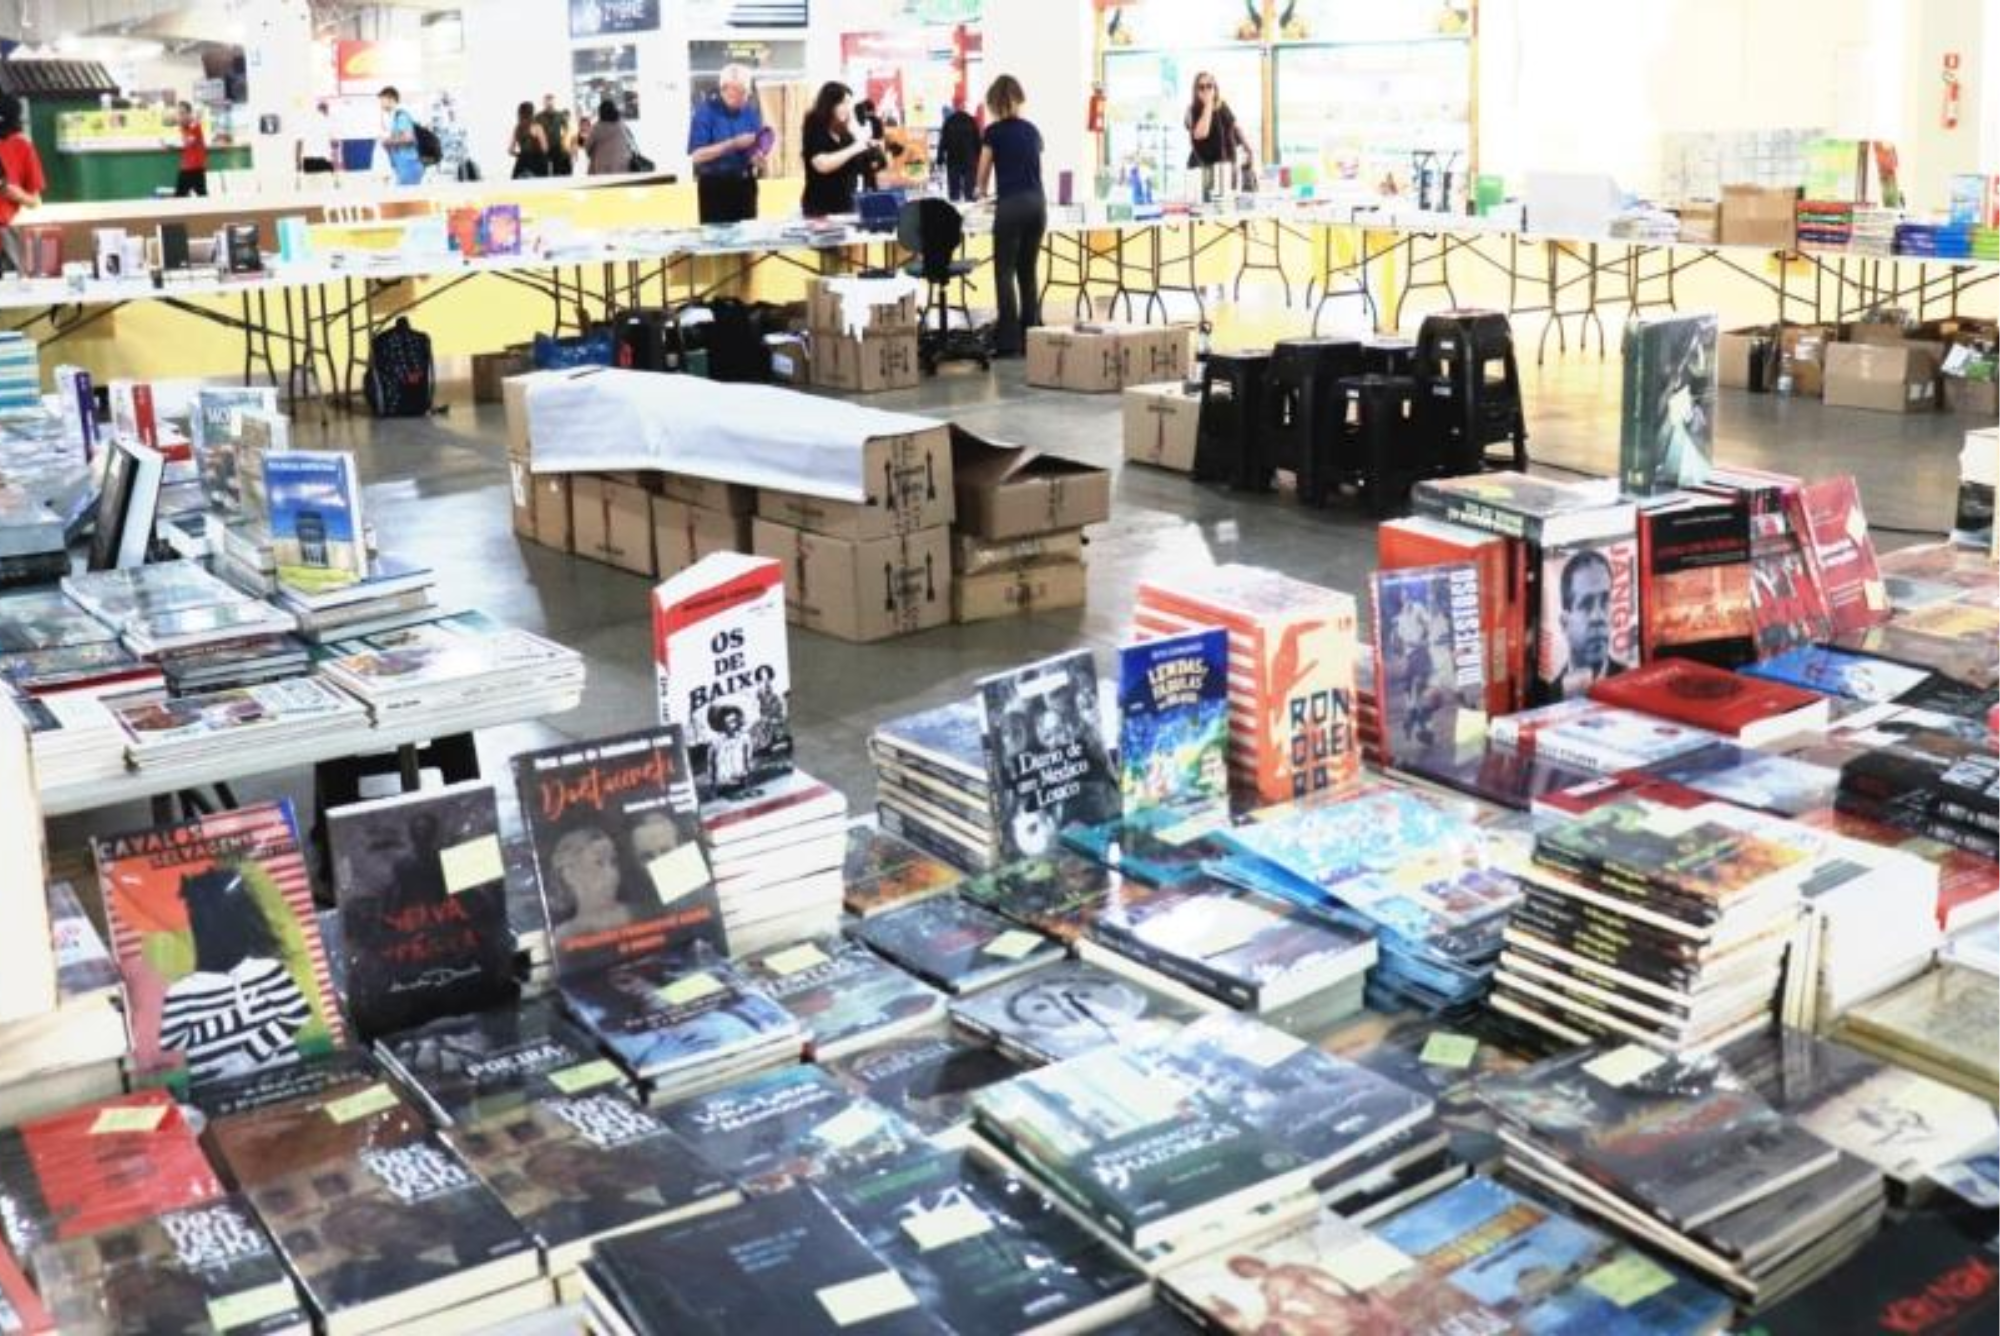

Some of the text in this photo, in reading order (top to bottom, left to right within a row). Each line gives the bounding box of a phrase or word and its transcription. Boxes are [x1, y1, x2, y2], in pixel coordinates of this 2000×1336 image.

[1610, 545, 1633, 655] JANGO
[711, 627, 745, 654] OS
[714, 652, 746, 677] DE
[689, 664, 776, 713] BAIXO
